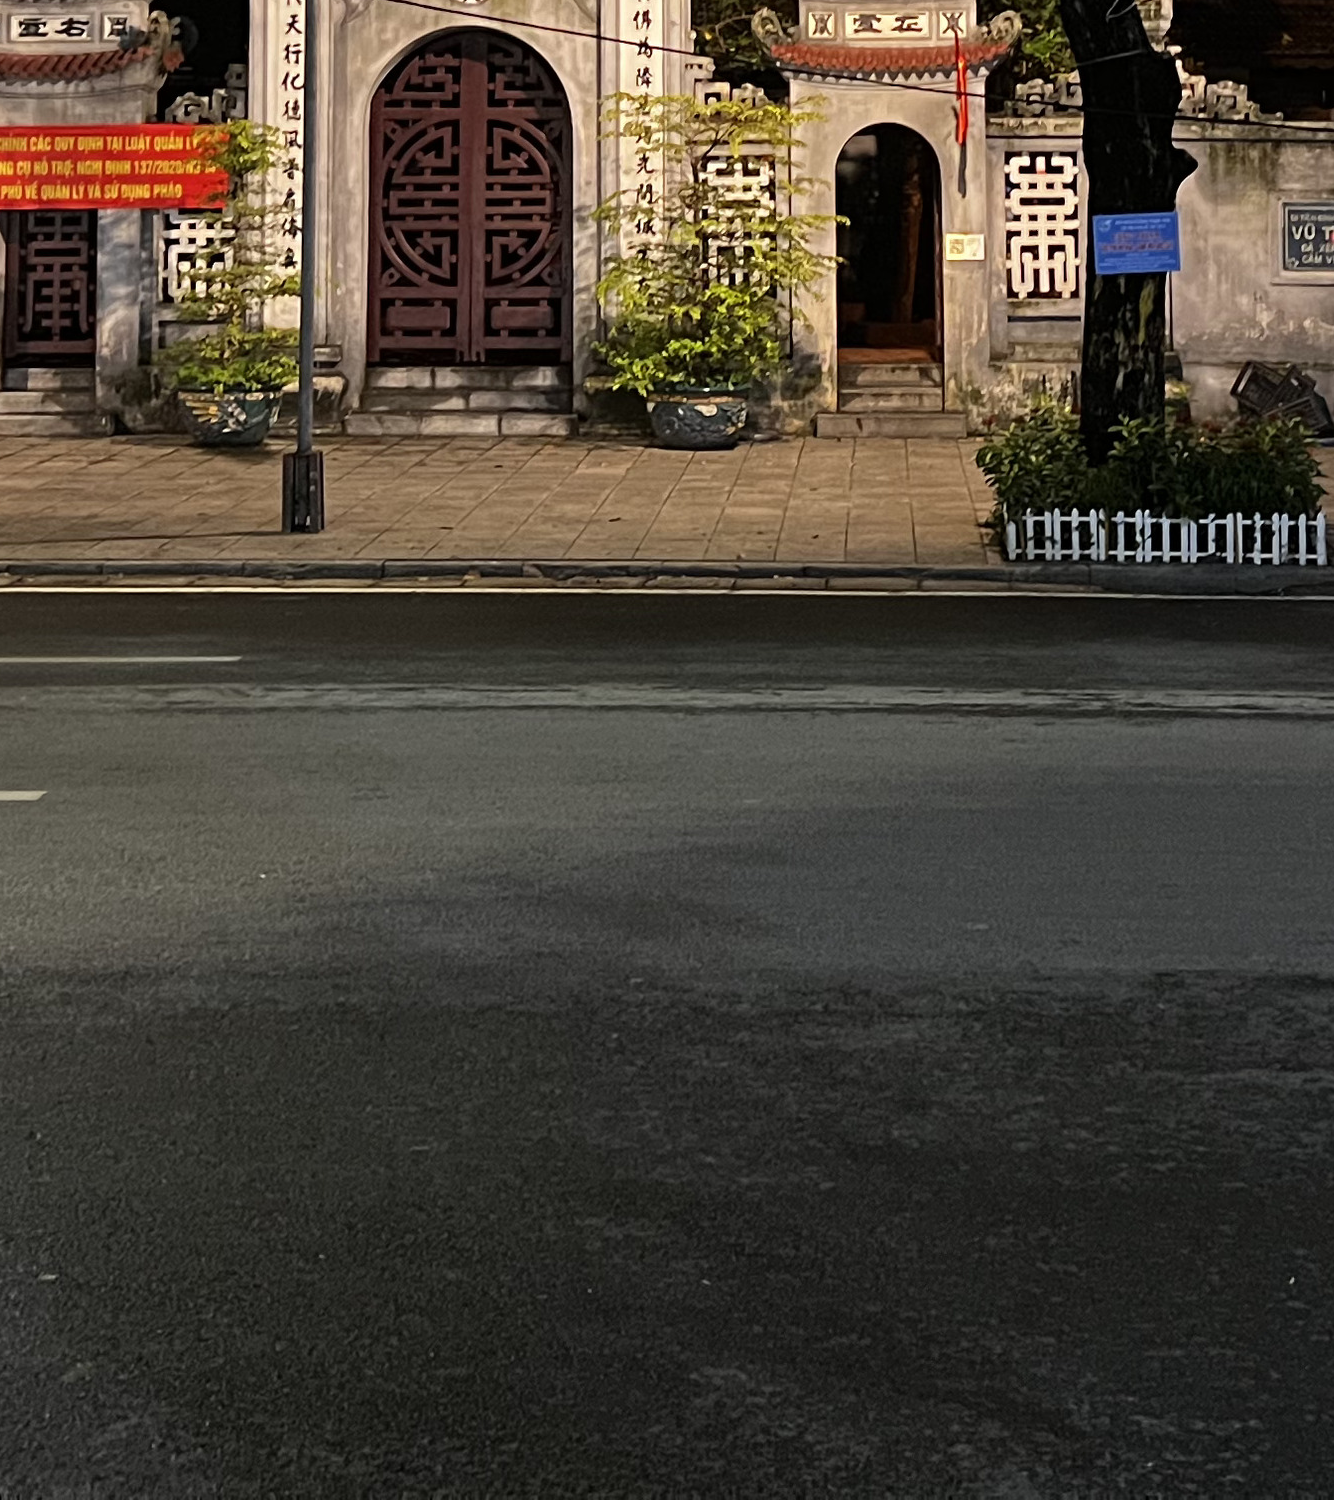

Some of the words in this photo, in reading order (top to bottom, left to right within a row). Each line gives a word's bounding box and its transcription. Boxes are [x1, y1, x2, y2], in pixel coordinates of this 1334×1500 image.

[30, 133, 51, 151] CÁC
[54, 136, 75, 151] QUY
[77, 136, 104, 154] ĐỊNH
[106, 136, 123, 154] TẠI
[125, 133, 152, 154] LUẬT
[154, 131, 184, 151] QUẢN
[17, 160, 32, 178] CỤ
[77, 160, 102, 179] NGHỊ
[105, 160, 131, 178] ĐỊNH
[0, 180, 22, 200] PHỦ
[41, 180, 70, 200] QUẢN
[72, 180, 85, 199] LÝ
[87, 181, 102, 199] VÀ
[121, 183, 151, 202] DỤNG
[153, 180, 183, 199] PHÁO
[1292, 223, 1316, 240] VŨ
